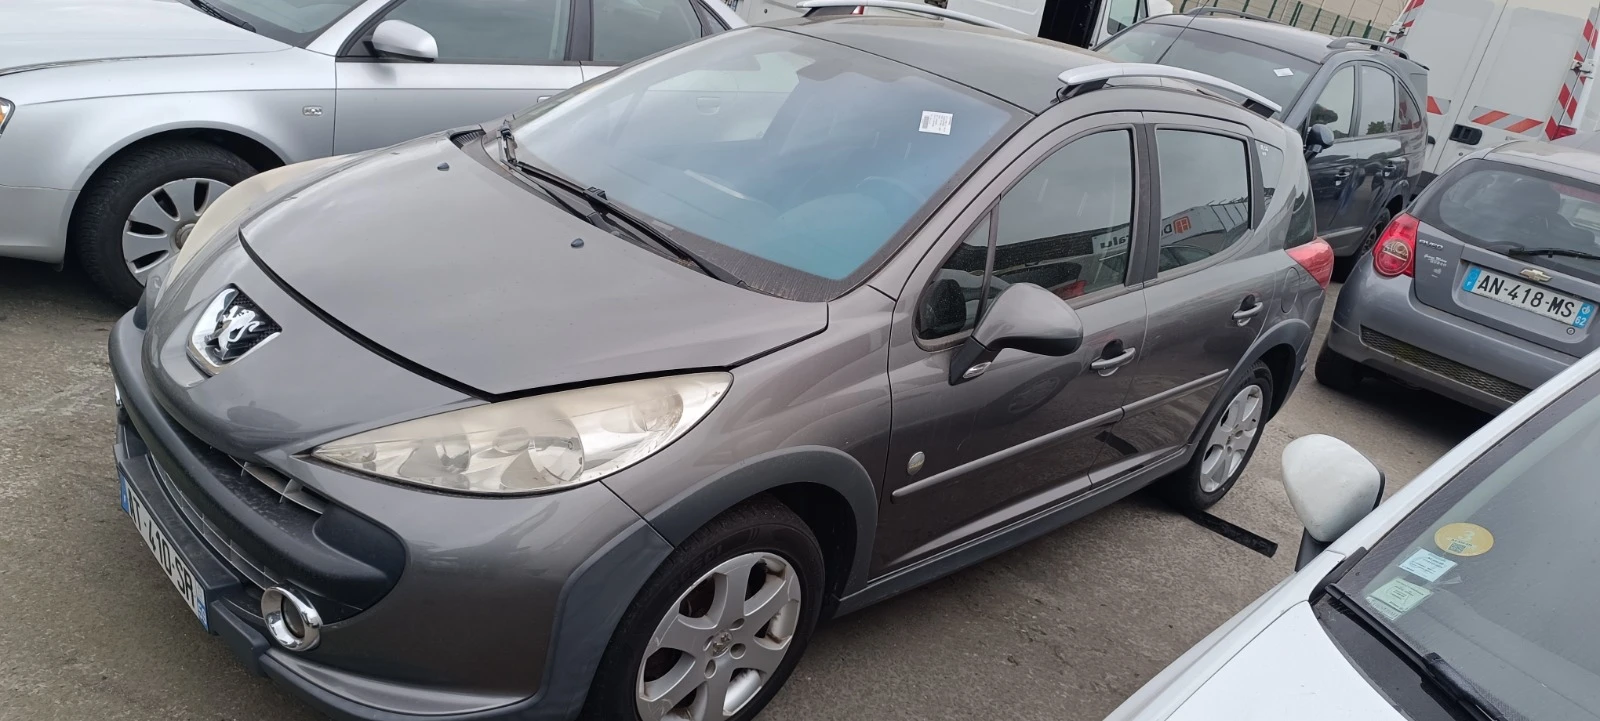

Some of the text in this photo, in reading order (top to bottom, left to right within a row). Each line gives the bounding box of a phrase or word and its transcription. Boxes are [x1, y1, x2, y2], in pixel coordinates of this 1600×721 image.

[1477, 275, 1575, 318] AN-418-MS
[1574, 316, 1587, 326] 62
[128, 487, 196, 609] AT-410-SR
